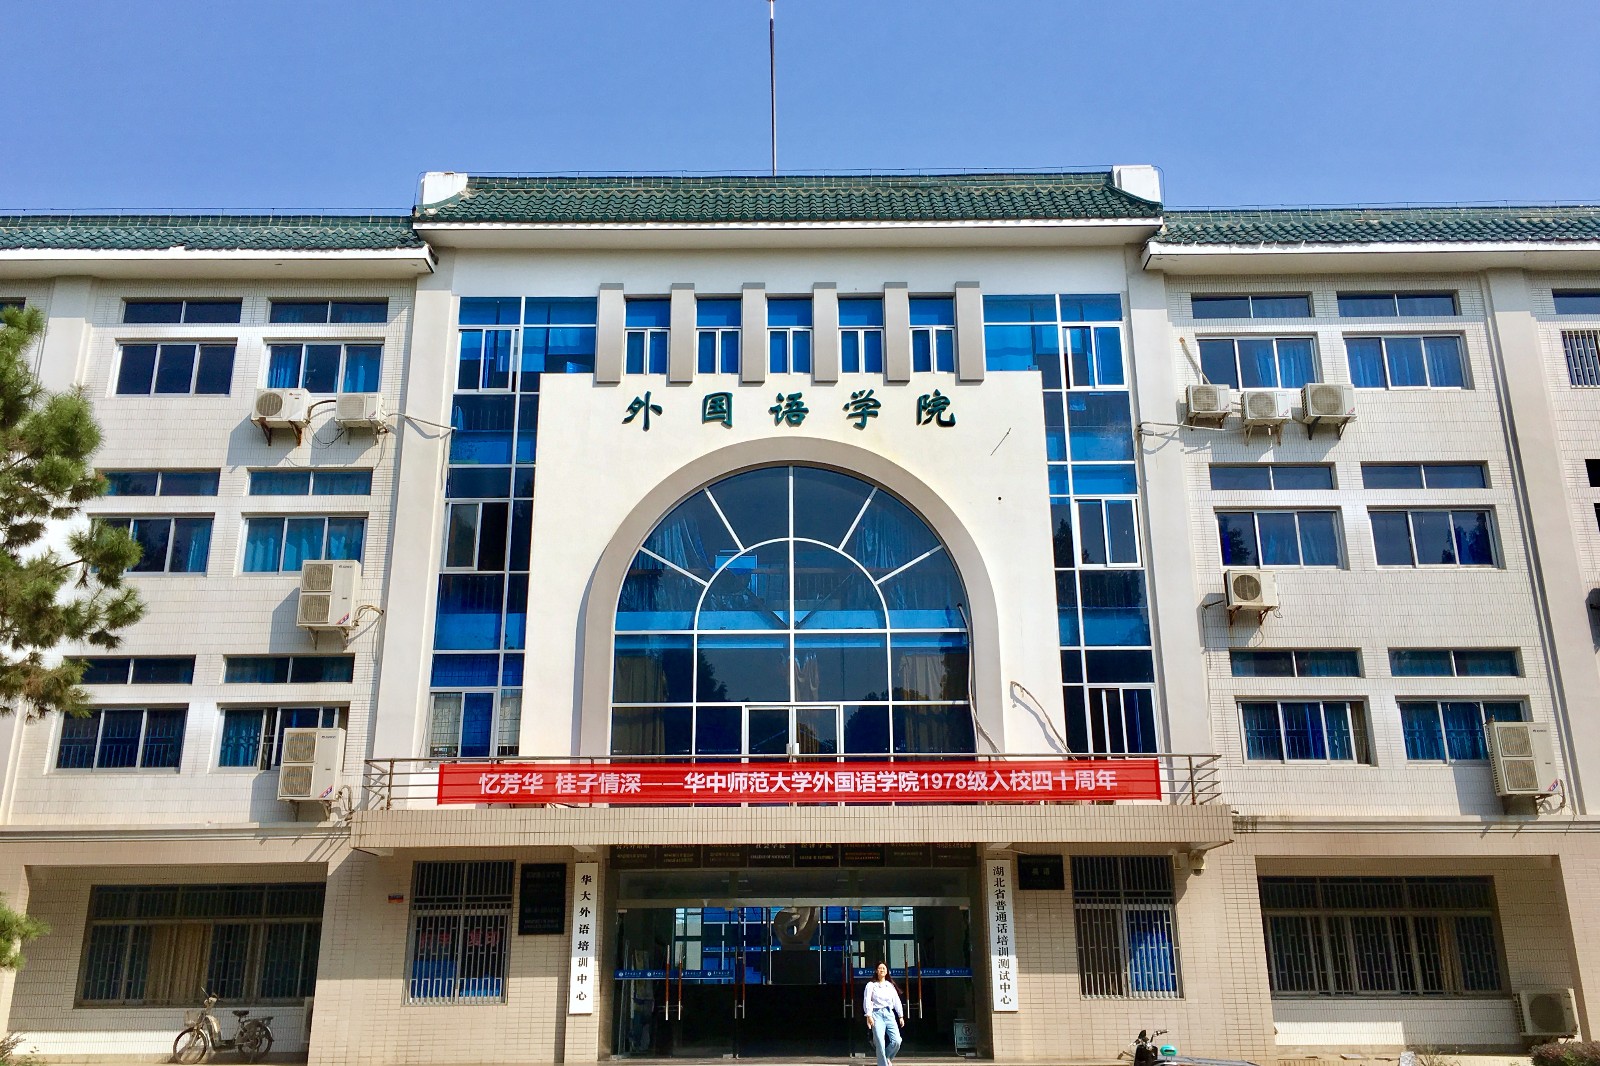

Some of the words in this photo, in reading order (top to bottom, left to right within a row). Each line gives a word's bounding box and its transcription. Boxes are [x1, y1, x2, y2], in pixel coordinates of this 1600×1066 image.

[622, 390, 956, 431] 外国语学院
[479, 772, 544, 795] 忆芳华
[575, 874, 592, 1001] 华大外语培训中心
[992, 865, 1012, 1005] 湖北省普通话培训测试中心
